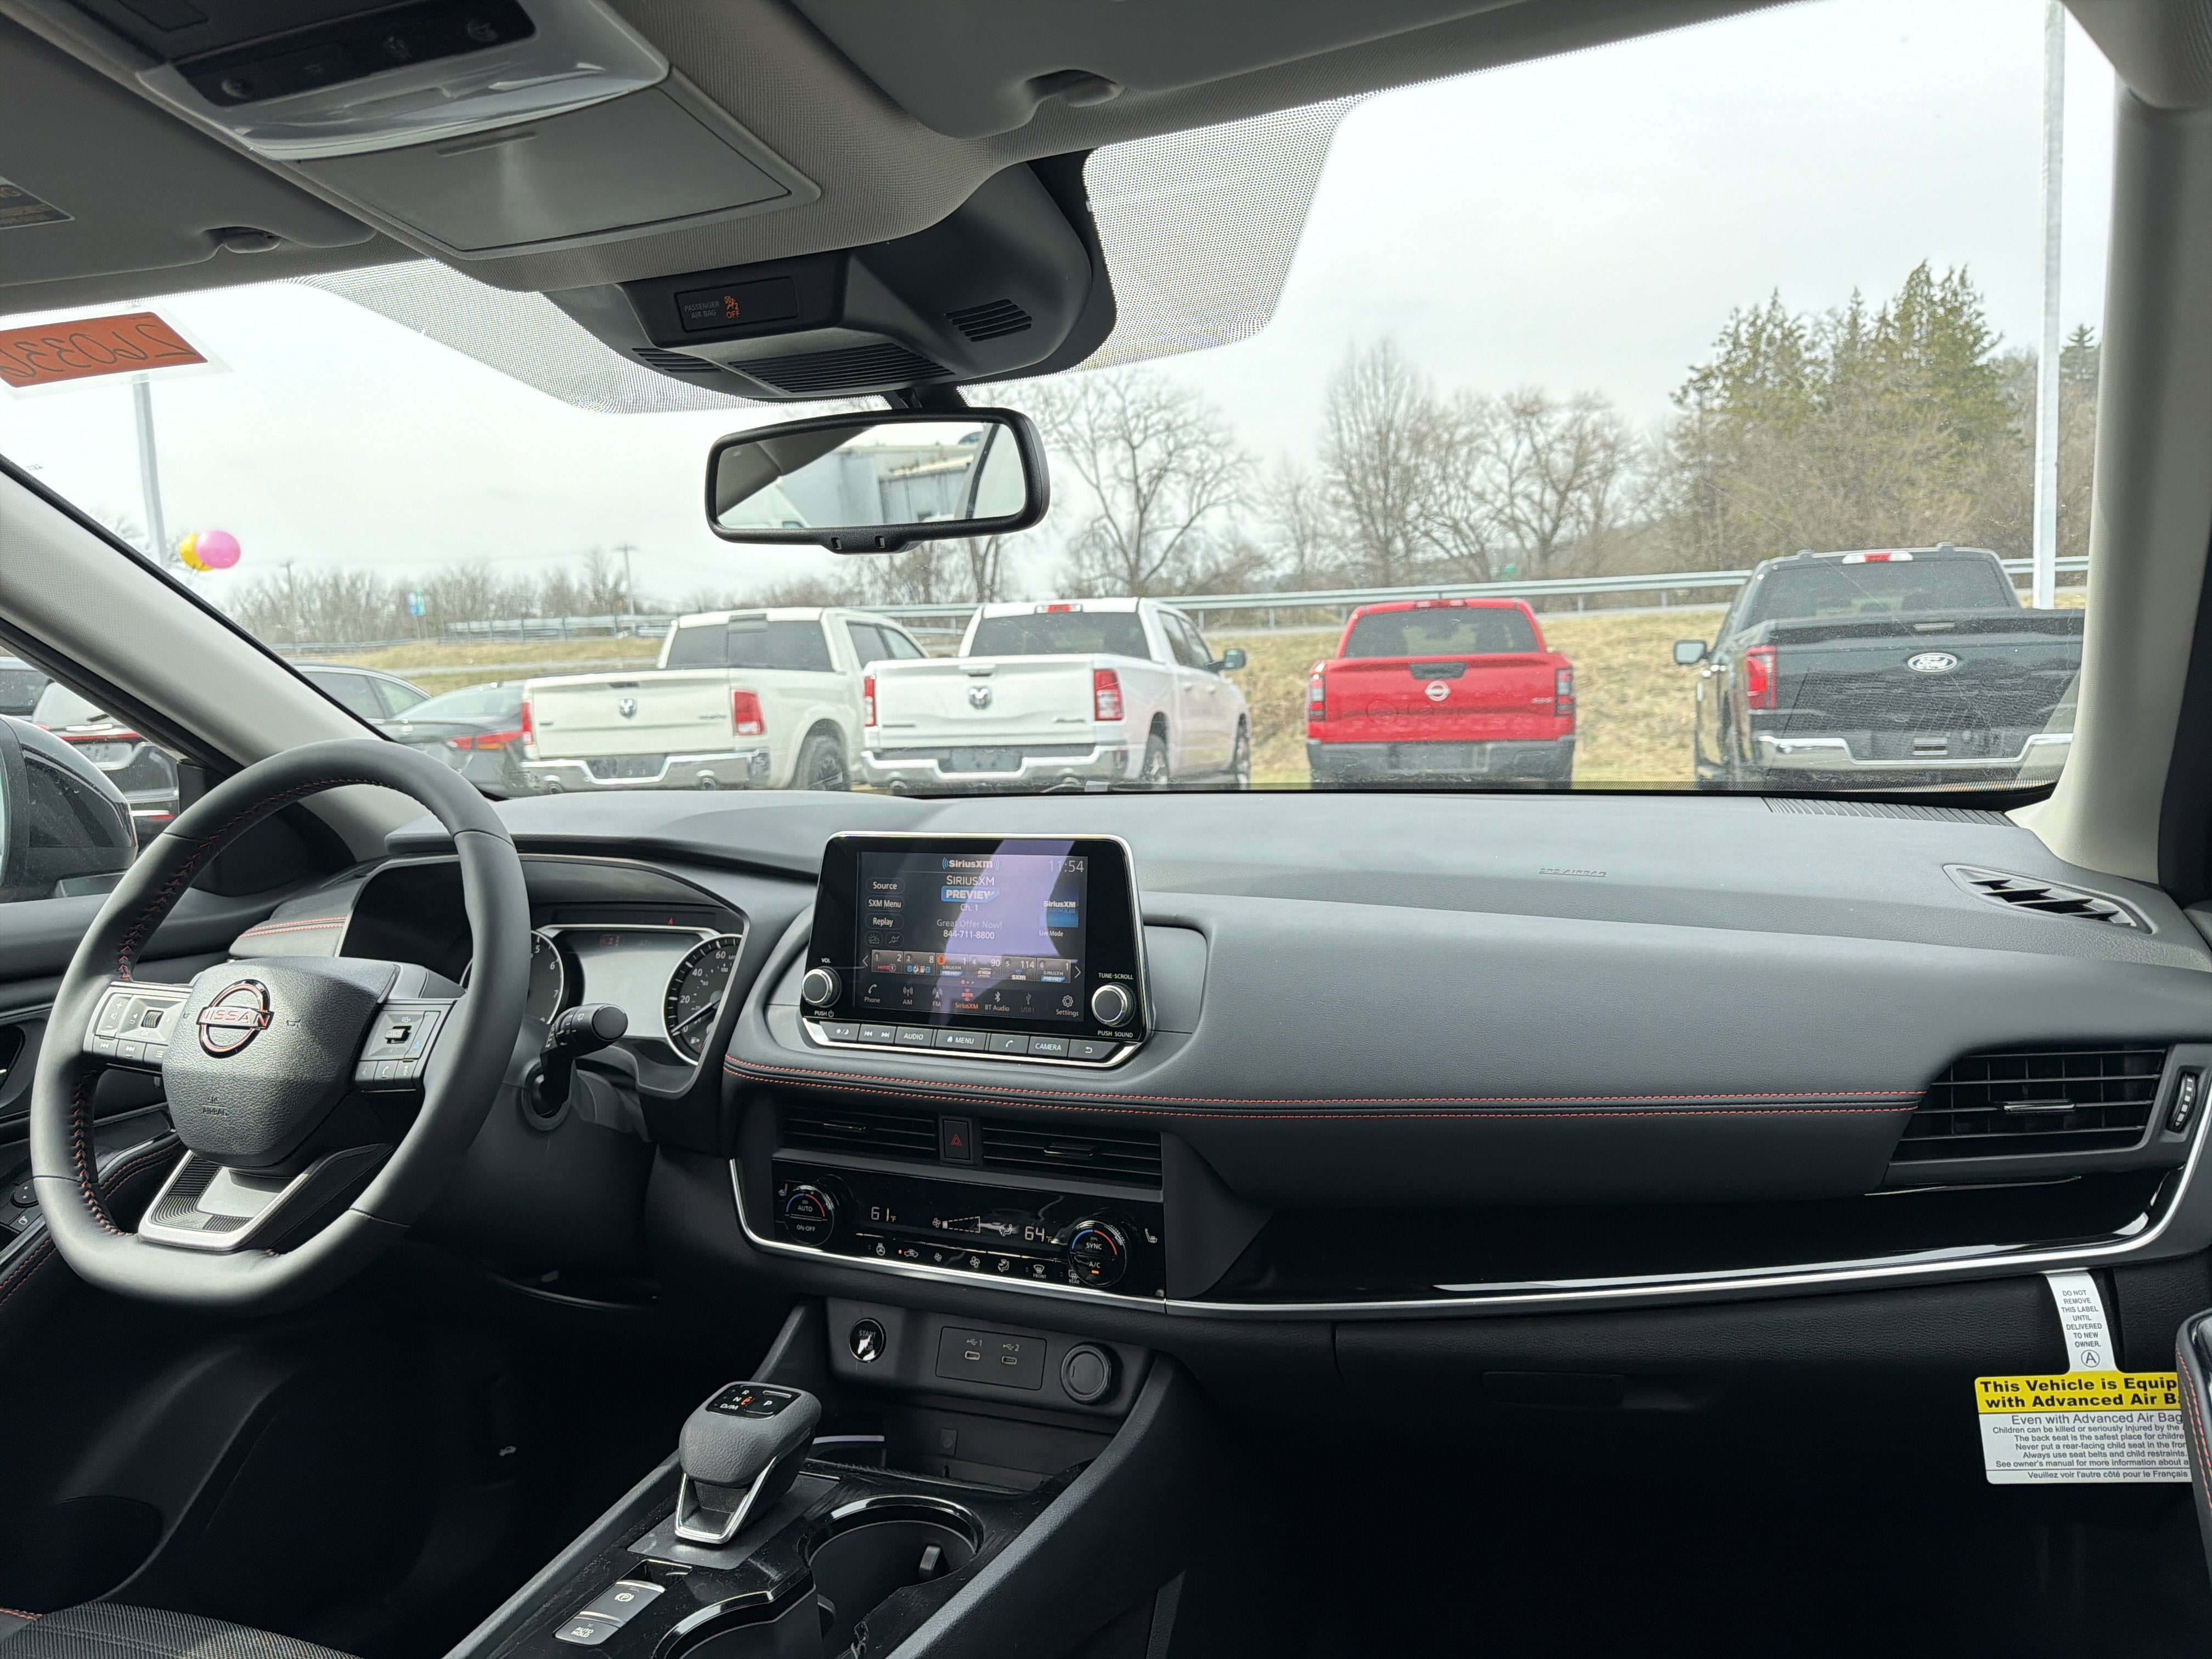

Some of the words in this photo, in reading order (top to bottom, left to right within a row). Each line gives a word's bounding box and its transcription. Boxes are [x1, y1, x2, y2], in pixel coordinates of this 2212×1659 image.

[684, 301, 720, 312] PASSENGER
[703, 309, 716, 318] BAG
[726, 310, 741, 319] OFF
[1914, 655, 1951, 670] Ford
[1049, 860, 1085, 873] 11:54
[946, 875, 995, 886] SIRIUSXM
[873, 882, 898, 890] Source
[946, 889, 995, 900] PREVIEW
[868, 899, 882, 907] SXM
[961, 903, 972, 911] Ch.
[873, 917, 894, 927] Replay
[936, 919, 958, 927] Great
[982, 921, 1002, 929] Now!
[943, 929, 995, 939] 844-711-8800
[535, 945, 540, 953] 5
[716, 951, 726, 959] 60
[929, 955, 934, 963] 8
[550, 961, 555, 970] 6
[991, 959, 1001, 967] 90
[1020, 961, 1035, 969] 114
[1065, 962, 1069, 970] 1
[692, 968, 703, 977] 40
[554, 989, 558, 998] 7
[680, 995, 690, 1003] 20
[199, 1008, 270, 1028] NISSAN
[1056, 1009, 1079, 1018] Settings
[1035, 1042, 1062, 1051] CAMERA
[1086, 1242, 1102, 1250] SYNC
[859, 1330, 877, 1338] START
[1980, 1380, 2020, 1392] This
[2025, 1379, 2095, 1391] Vehicle
[2101, 1378, 2118, 1390] is
[1985, 1396, 2025, 1408] with
[2032, 1393, 2124, 1407] Advanced
[2130, 1393, 2157, 1405] Air
[2164, 1393, 2181, 1404] B
[2012, 1415, 2042, 1425] Even
[2045, 1414, 2069, 1424] with
[2073, 1413, 2134, 1424] Advanced
[2137, 1413, 2154, 1423] Air
[2088, 1425, 2123, 1433] seriously
[2125, 1425, 2152, 1433] injured
[2023, 1452, 2051, 1460] Always
[2153, 1470, 2188, 1479] Français
[571, 1630, 589, 1639] HOLD
